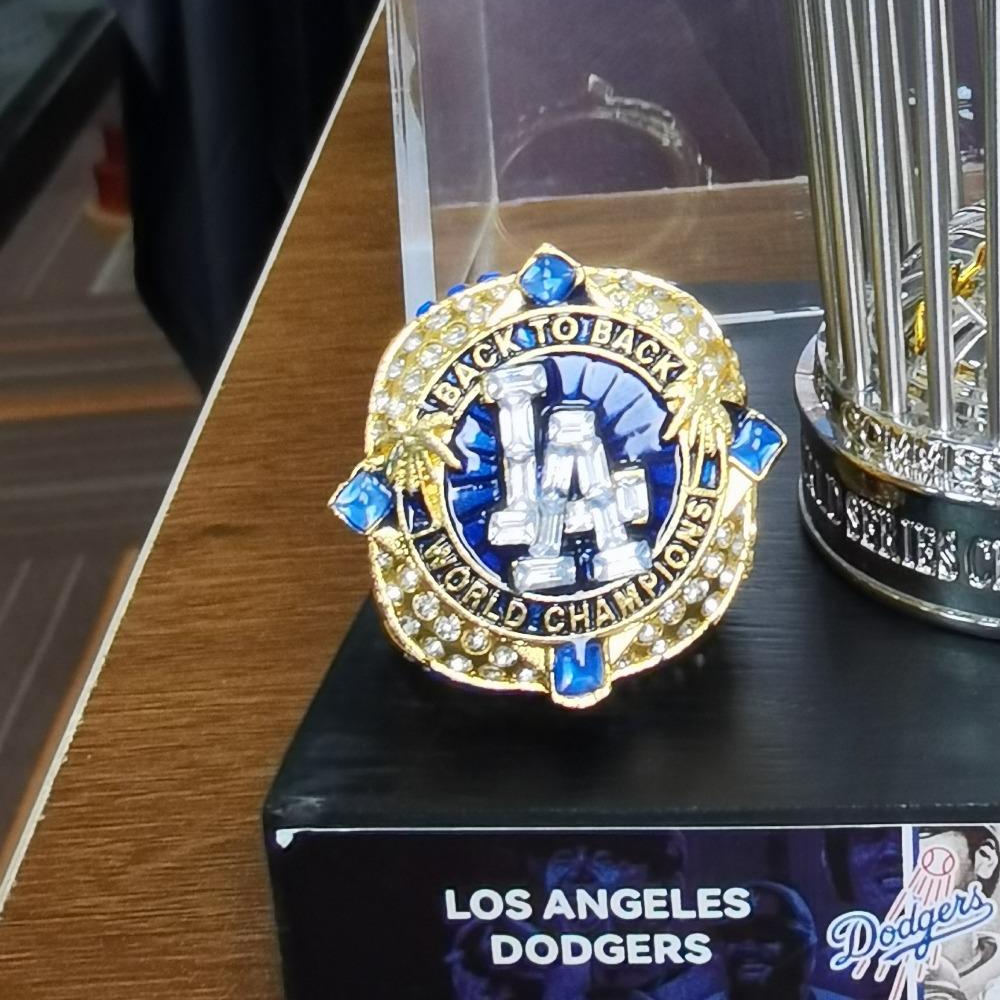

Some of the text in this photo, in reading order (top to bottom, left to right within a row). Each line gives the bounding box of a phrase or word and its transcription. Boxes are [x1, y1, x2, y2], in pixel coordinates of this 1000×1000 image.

[430, 314, 685, 407] BACK TO BACK
[424, 498, 713, 633] WORLD CHAMPIONS
[445, 887, 752, 921] LOS ANGELES
[828, 881, 995, 968] Dodgers
[491, 932, 713, 966] DODGERS
